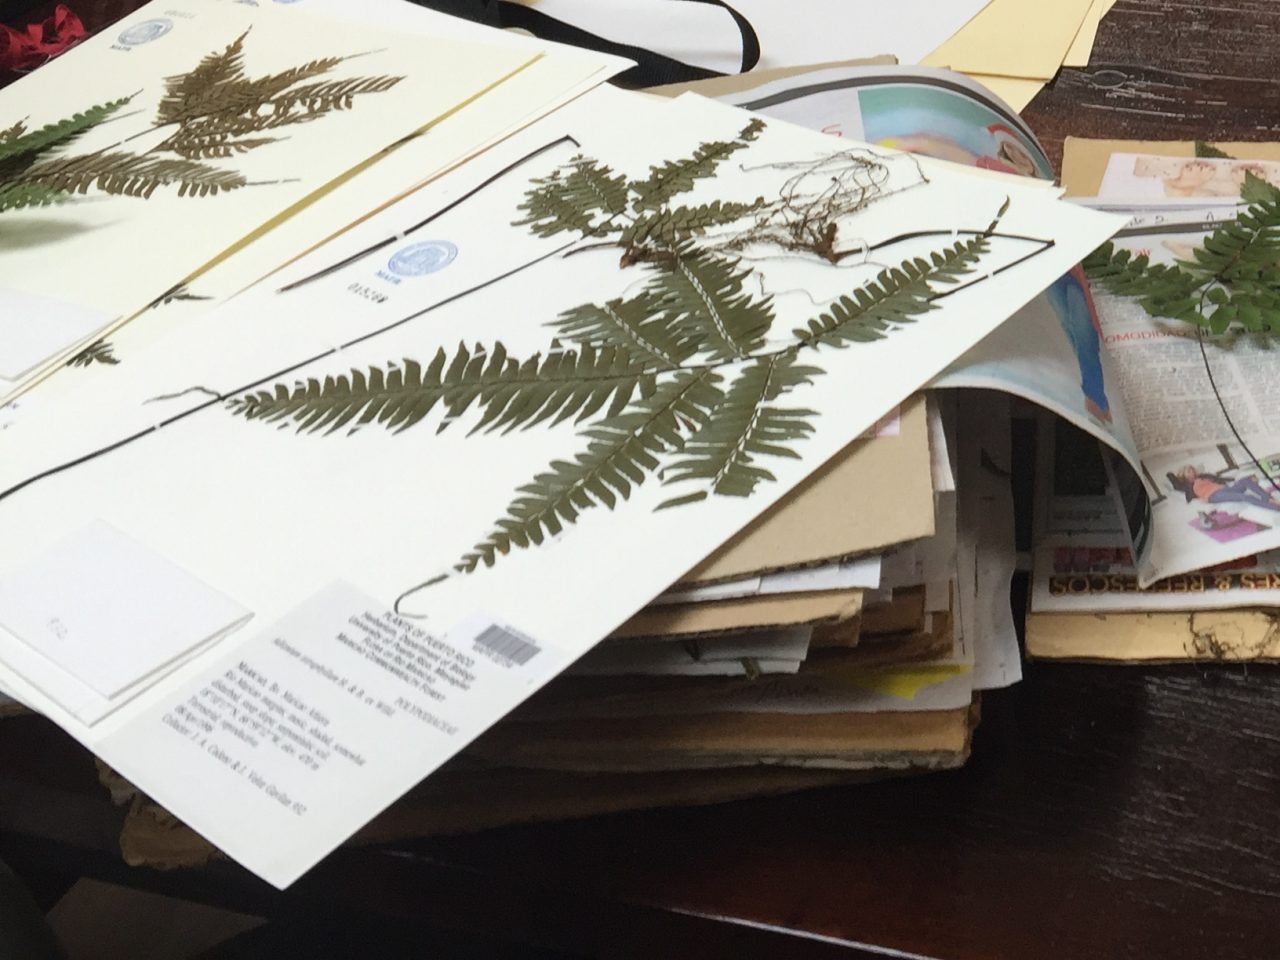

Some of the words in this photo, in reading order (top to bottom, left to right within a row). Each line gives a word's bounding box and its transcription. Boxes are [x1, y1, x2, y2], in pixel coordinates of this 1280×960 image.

[1214, 576, 1233, 592] &
[424, 635, 455, 655] PUERTO
[455, 652, 474, 667] RICO
